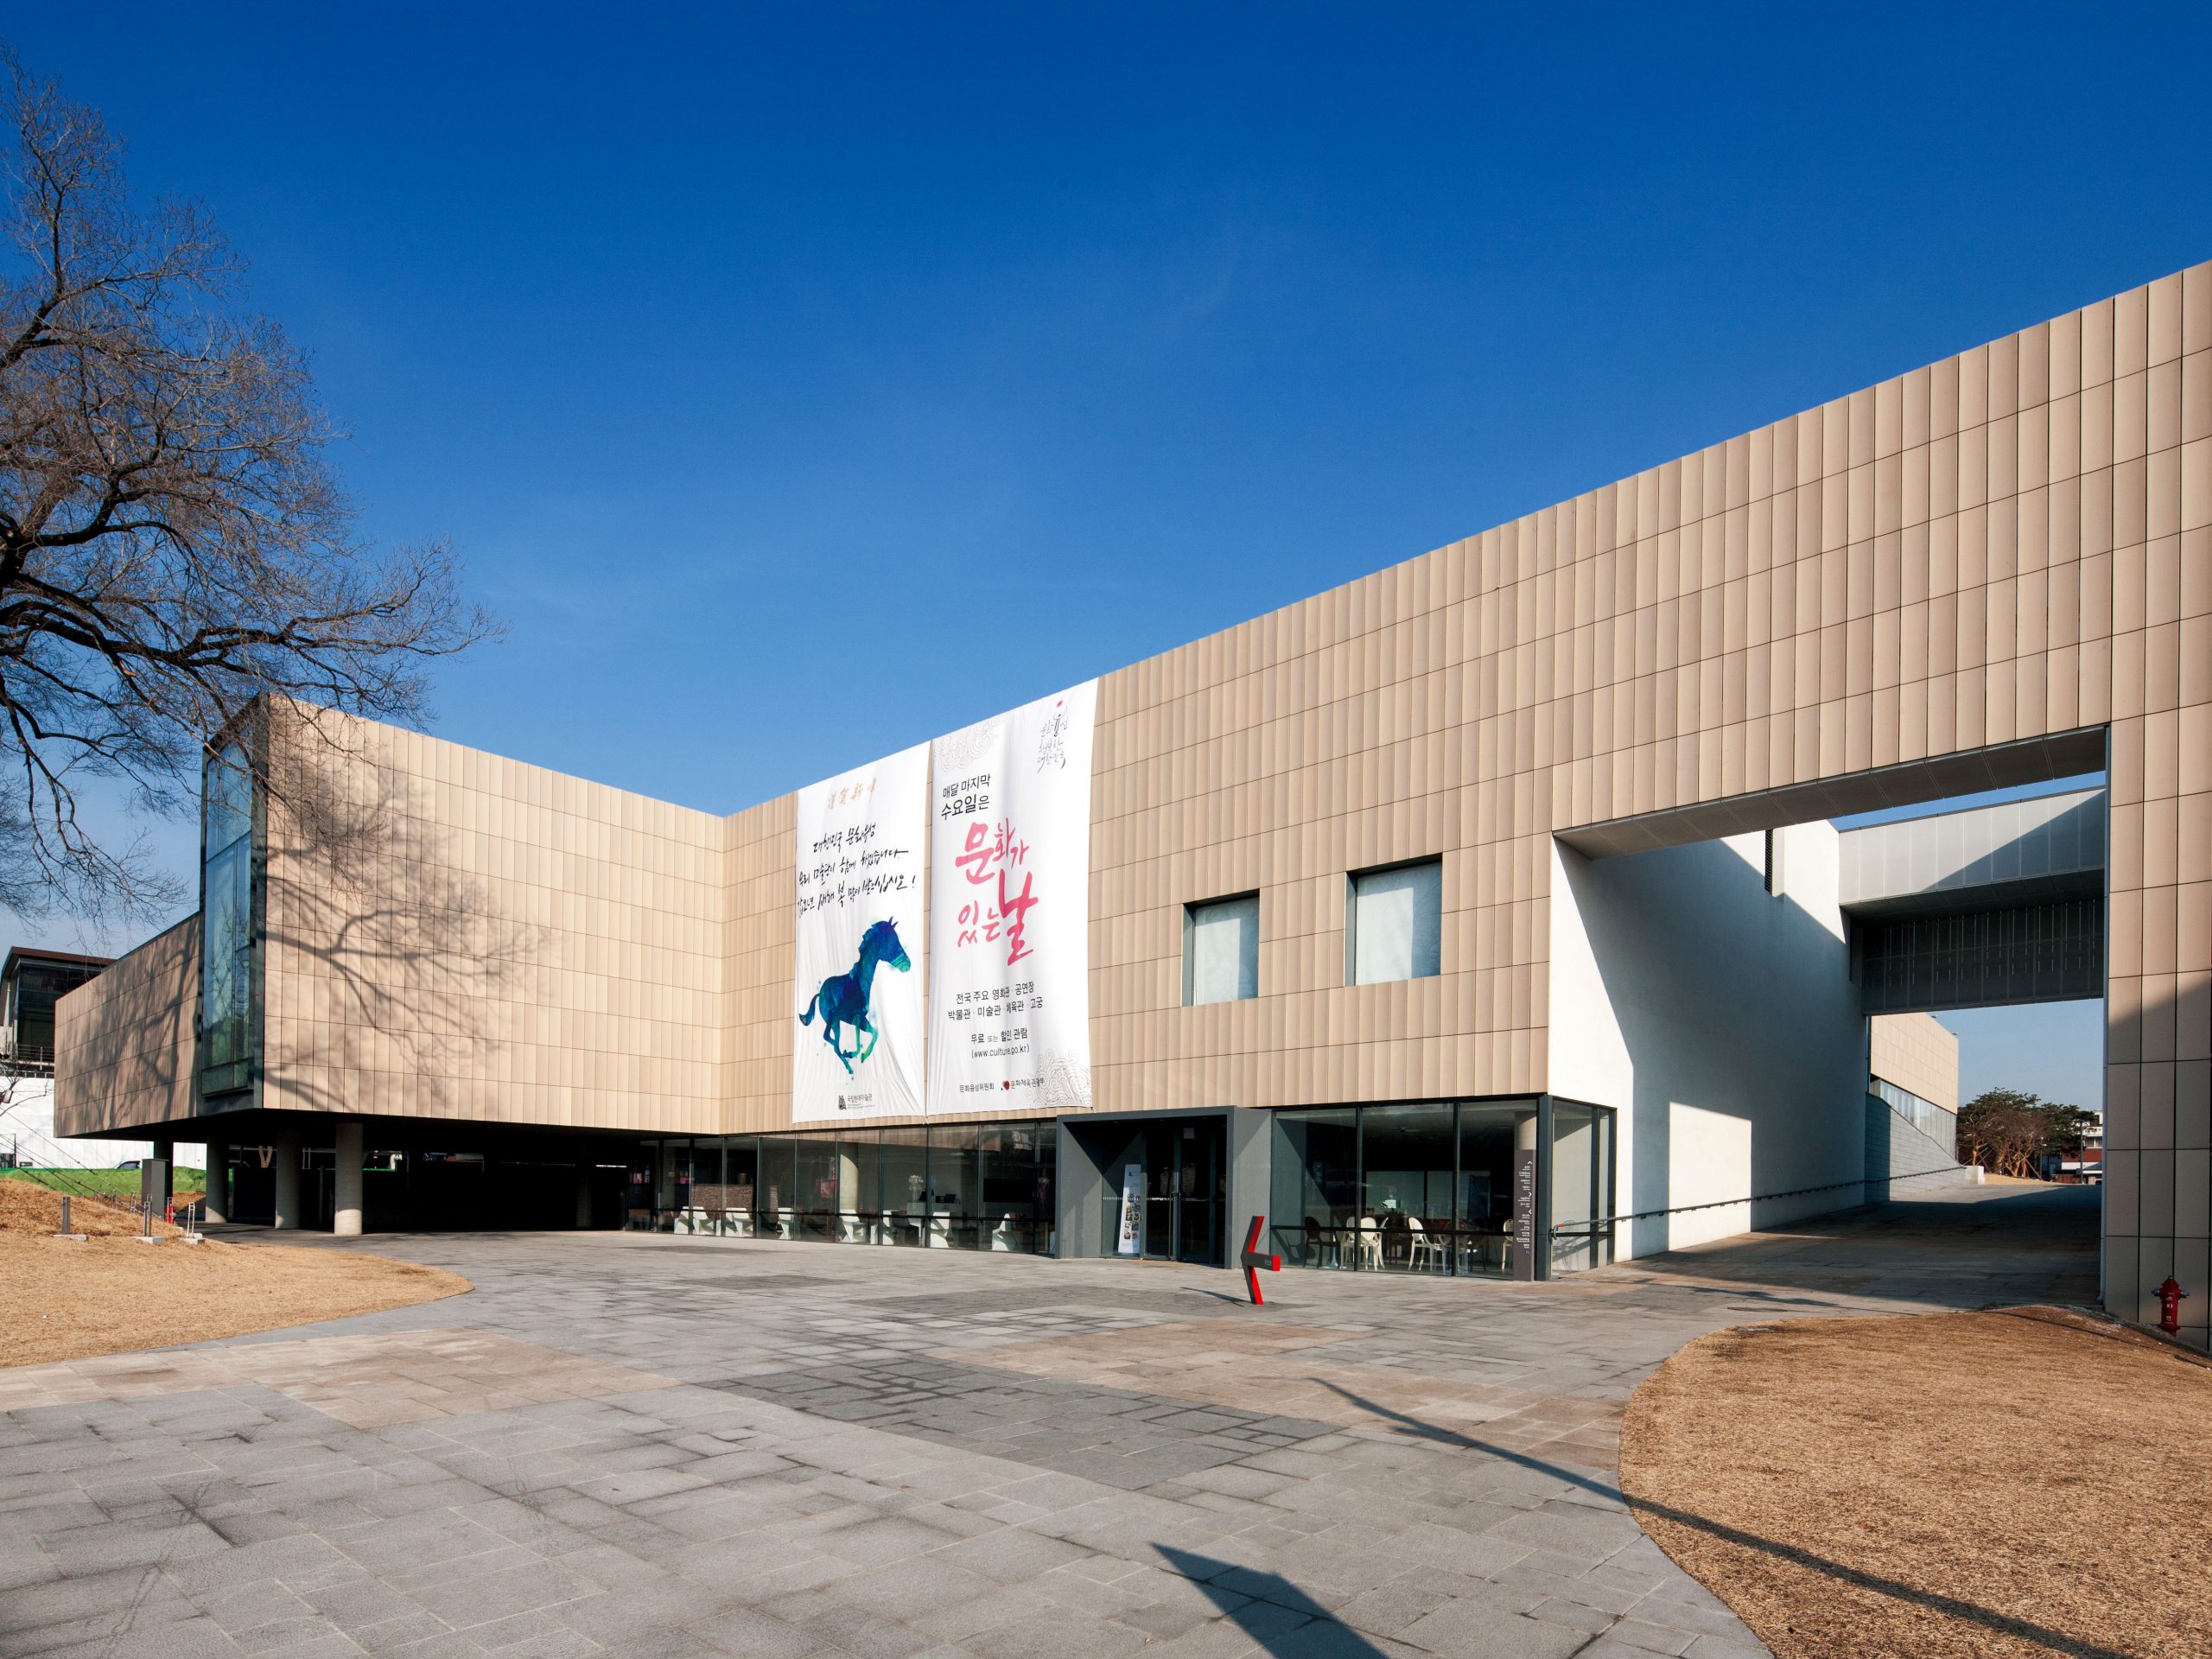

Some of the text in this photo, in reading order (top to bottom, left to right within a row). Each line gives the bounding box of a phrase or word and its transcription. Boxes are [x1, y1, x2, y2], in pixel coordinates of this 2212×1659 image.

[943, 773, 991, 798] 매달 마지막
[941, 794, 990, 821] 수요일은
[813, 831, 843, 853] 대한민국
[955, 817, 1029, 885] 문화가
[837, 880, 845, 908] 복
[957, 868, 1039, 966] 있는 날
[956, 992, 971, 1005] 전국
[973, 990, 989, 1002] 주요
[970, 1033, 985, 1045] 무료
[1001, 1029, 1012, 1042] 할인
[1014, 1027, 1028, 1039] 관람
